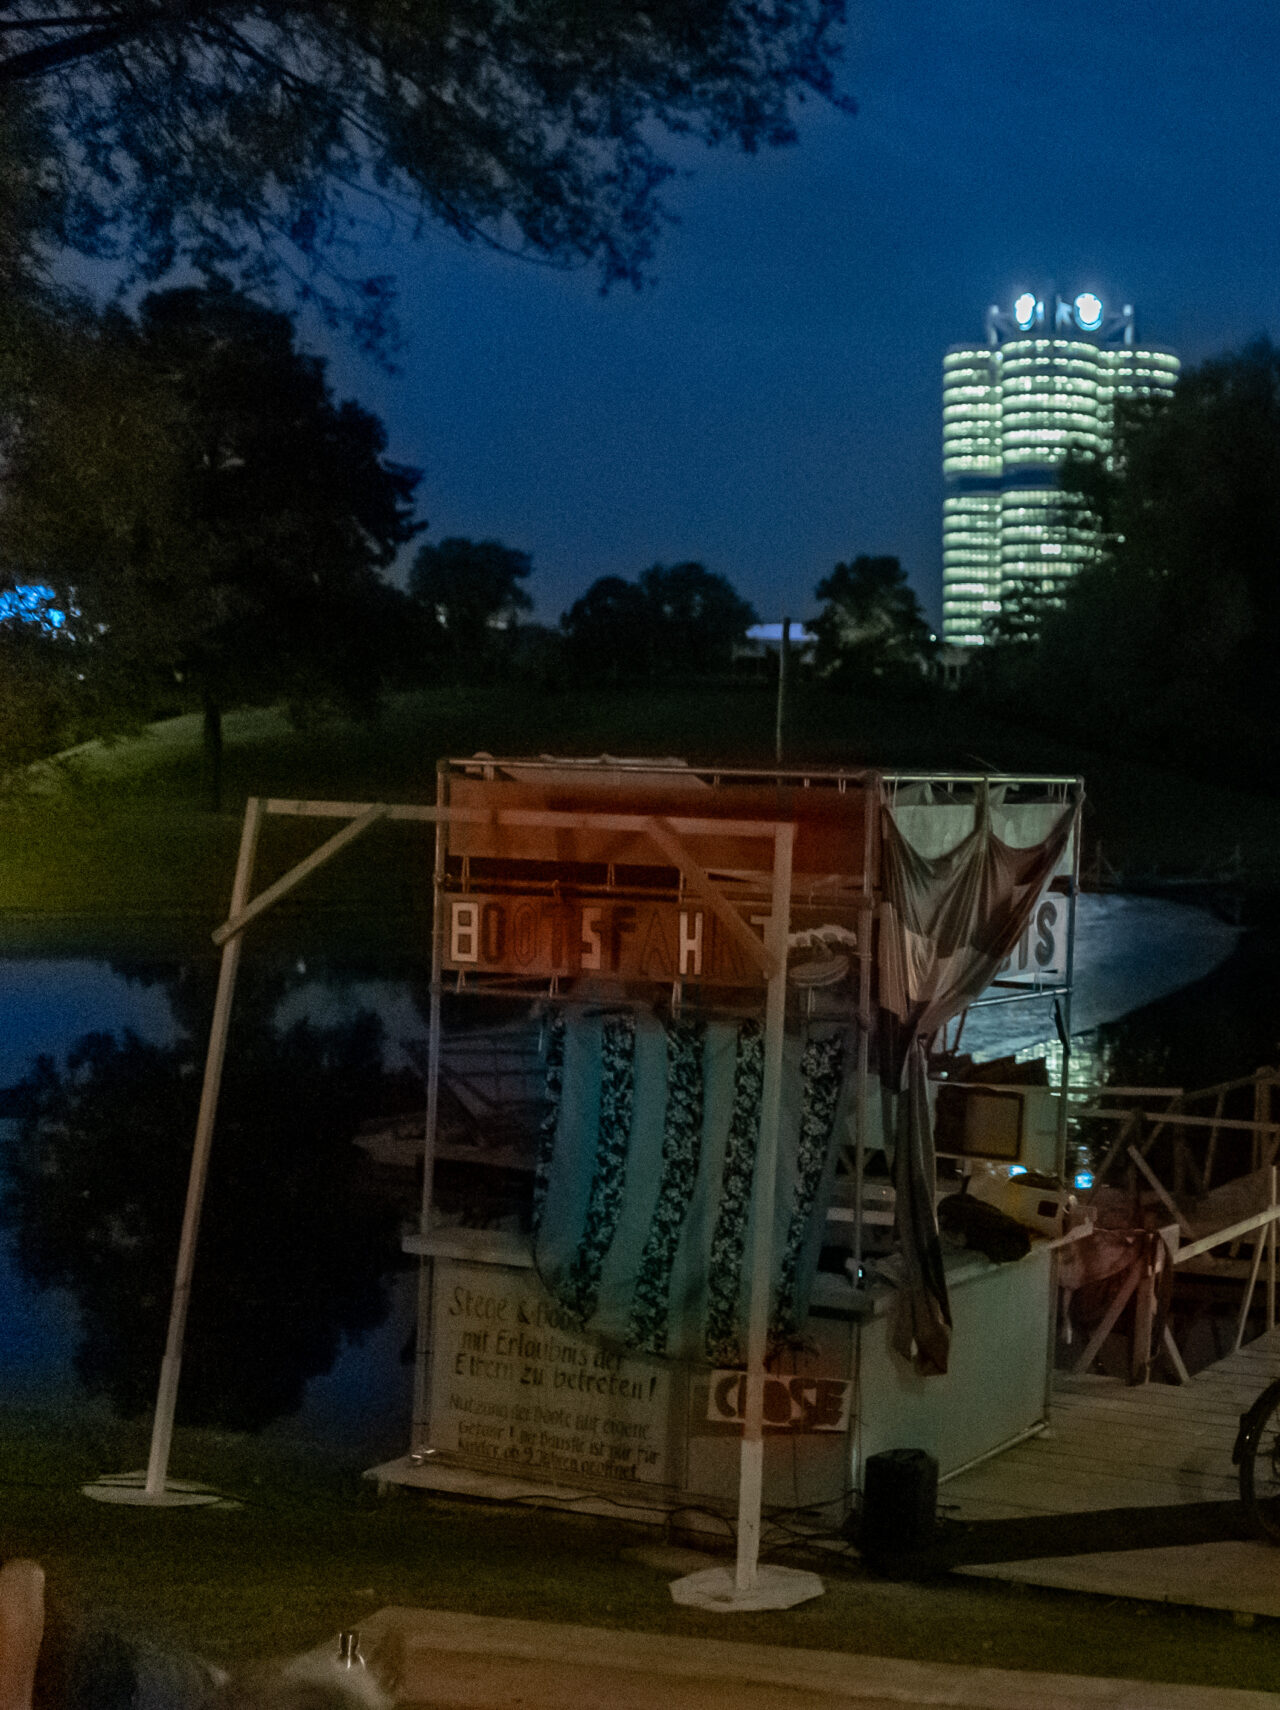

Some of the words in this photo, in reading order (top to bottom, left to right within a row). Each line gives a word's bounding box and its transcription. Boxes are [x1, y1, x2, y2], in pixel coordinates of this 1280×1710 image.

[461, 1329, 488, 1353] mit
[495, 1329, 588, 1366] Erlaubnis
[593, 1346, 624, 1371] der
[519, 1365, 543, 1386] zu
